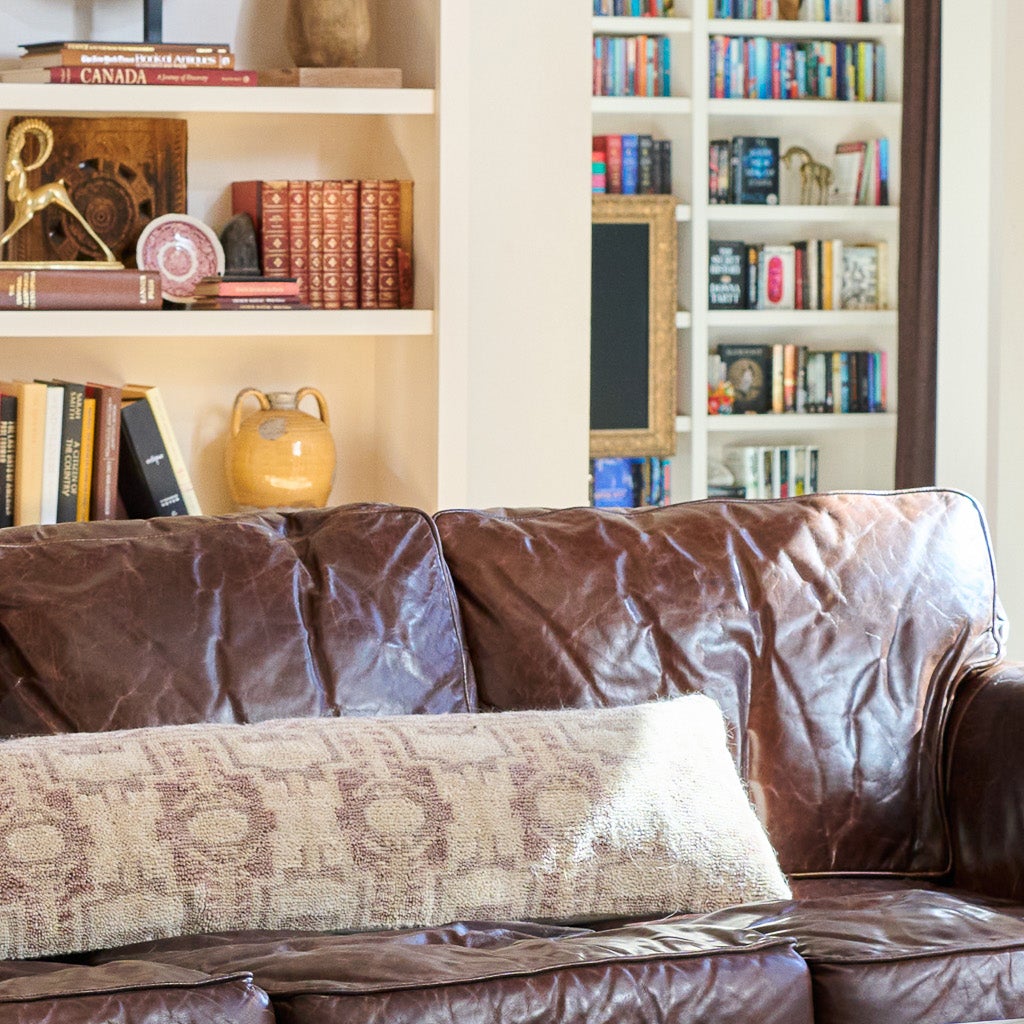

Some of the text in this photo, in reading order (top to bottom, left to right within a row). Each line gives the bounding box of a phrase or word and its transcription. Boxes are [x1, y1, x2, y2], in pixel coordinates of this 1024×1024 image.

[80, 69, 147, 84] CANADA
[75, 392, 83, 420] SARAH
[62, 454, 72, 497] COUNTRY
[72, 450, 80, 482] CITIZEN
